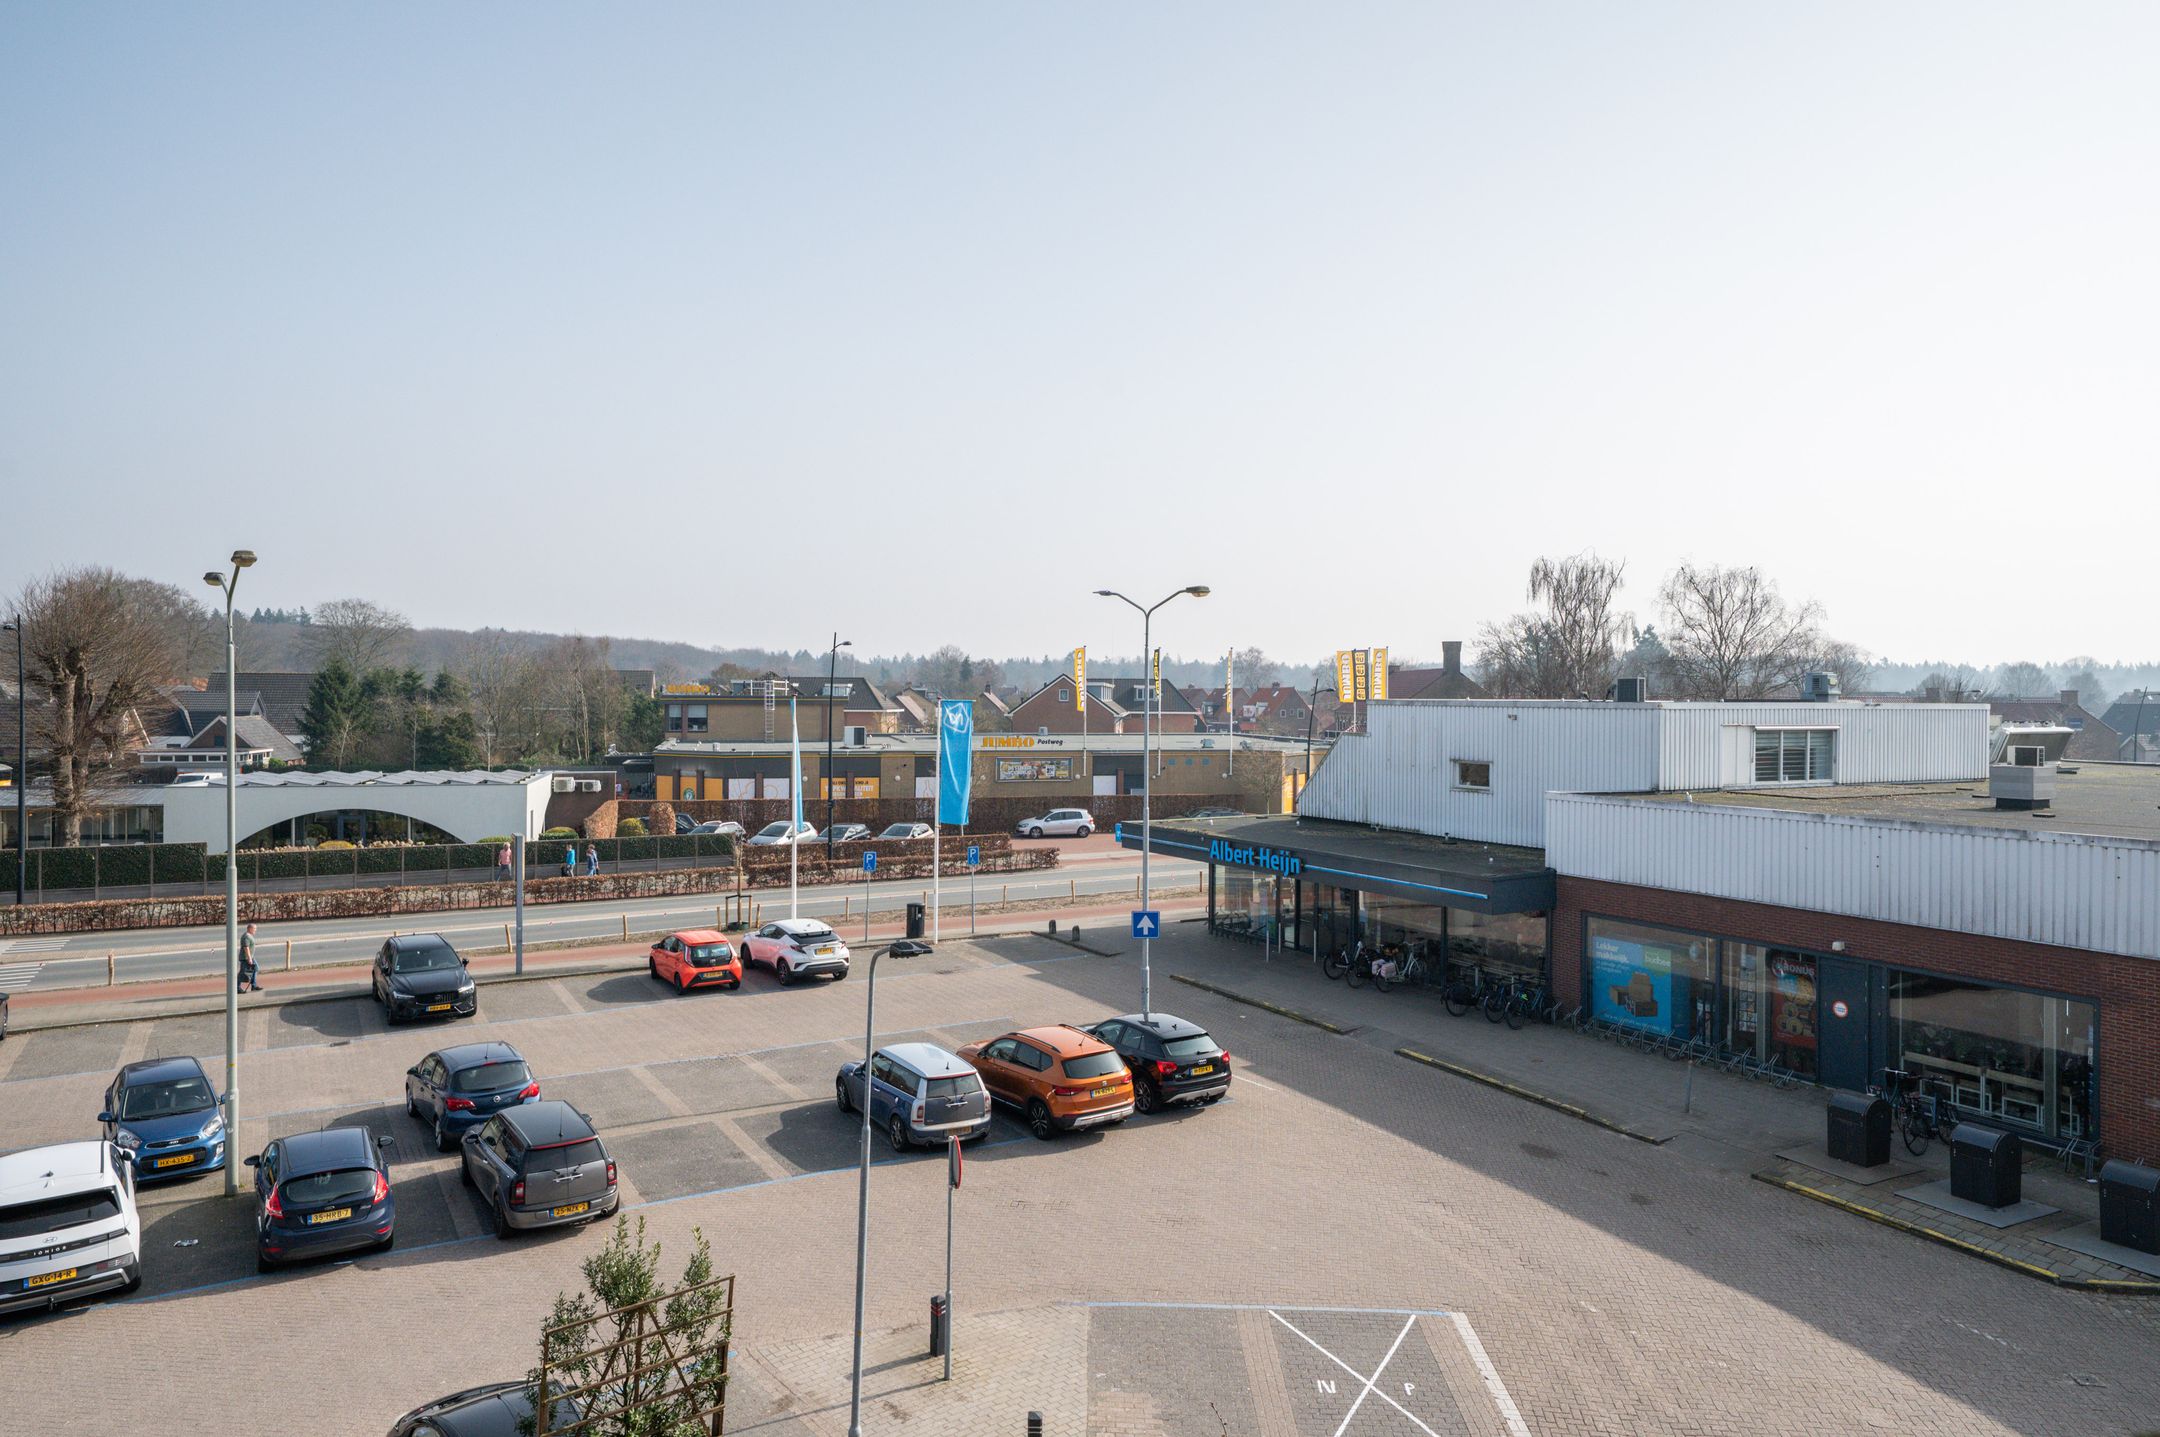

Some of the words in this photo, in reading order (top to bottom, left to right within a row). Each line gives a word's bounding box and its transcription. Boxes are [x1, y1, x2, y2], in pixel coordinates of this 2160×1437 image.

[981, 736, 1035, 748] JUMBO
[1037, 738, 1064, 747] Postweg
[866, 853, 873, 863] P
[970, 848, 977, 858] P
[1210, 840, 1255, 866] Albert
[1260, 848, 1300, 877] Heijn
[1317, 1380, 1336, 1394] N
[1404, 1383, 1415, 1396] P
